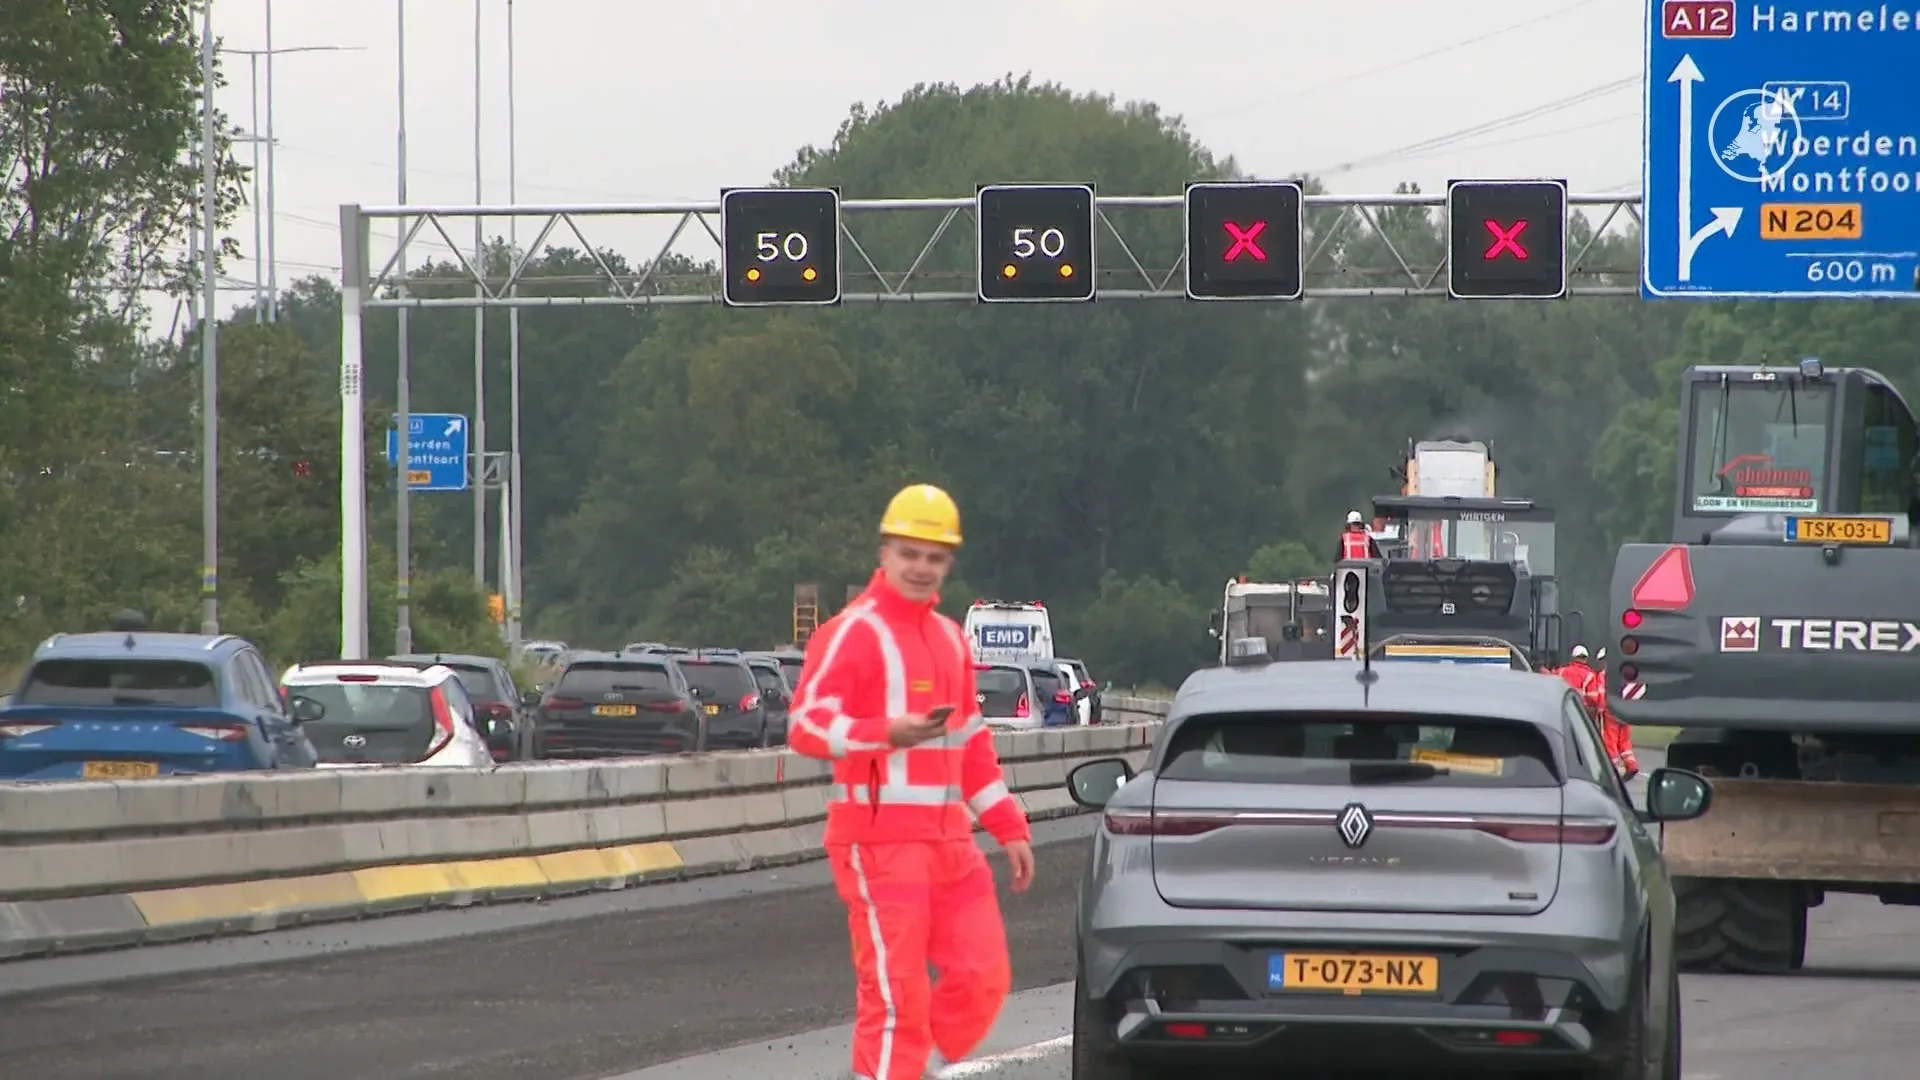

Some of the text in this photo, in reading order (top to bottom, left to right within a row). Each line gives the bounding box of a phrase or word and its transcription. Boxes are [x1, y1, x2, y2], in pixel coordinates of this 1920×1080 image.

[1671, 8, 1728, 31] A12
[1752, 4, 1920, 32] Harmele
[1812, 91, 1842, 112] 14
[1762, 130, 1917, 157] Woerden
[756, 233, 809, 262] 50
[1013, 228, 1065, 258] 50
[1807, 261, 1896, 282] 600 m
[1459, 511, 1505, 522] WIRTGEN
[1804, 521, 1882, 539] TSK-03-L
[985, 630, 1025, 644] EMD
[1771, 619, 1920, 652] TEREX
[1293, 958, 1424, 986] T-073-NX
